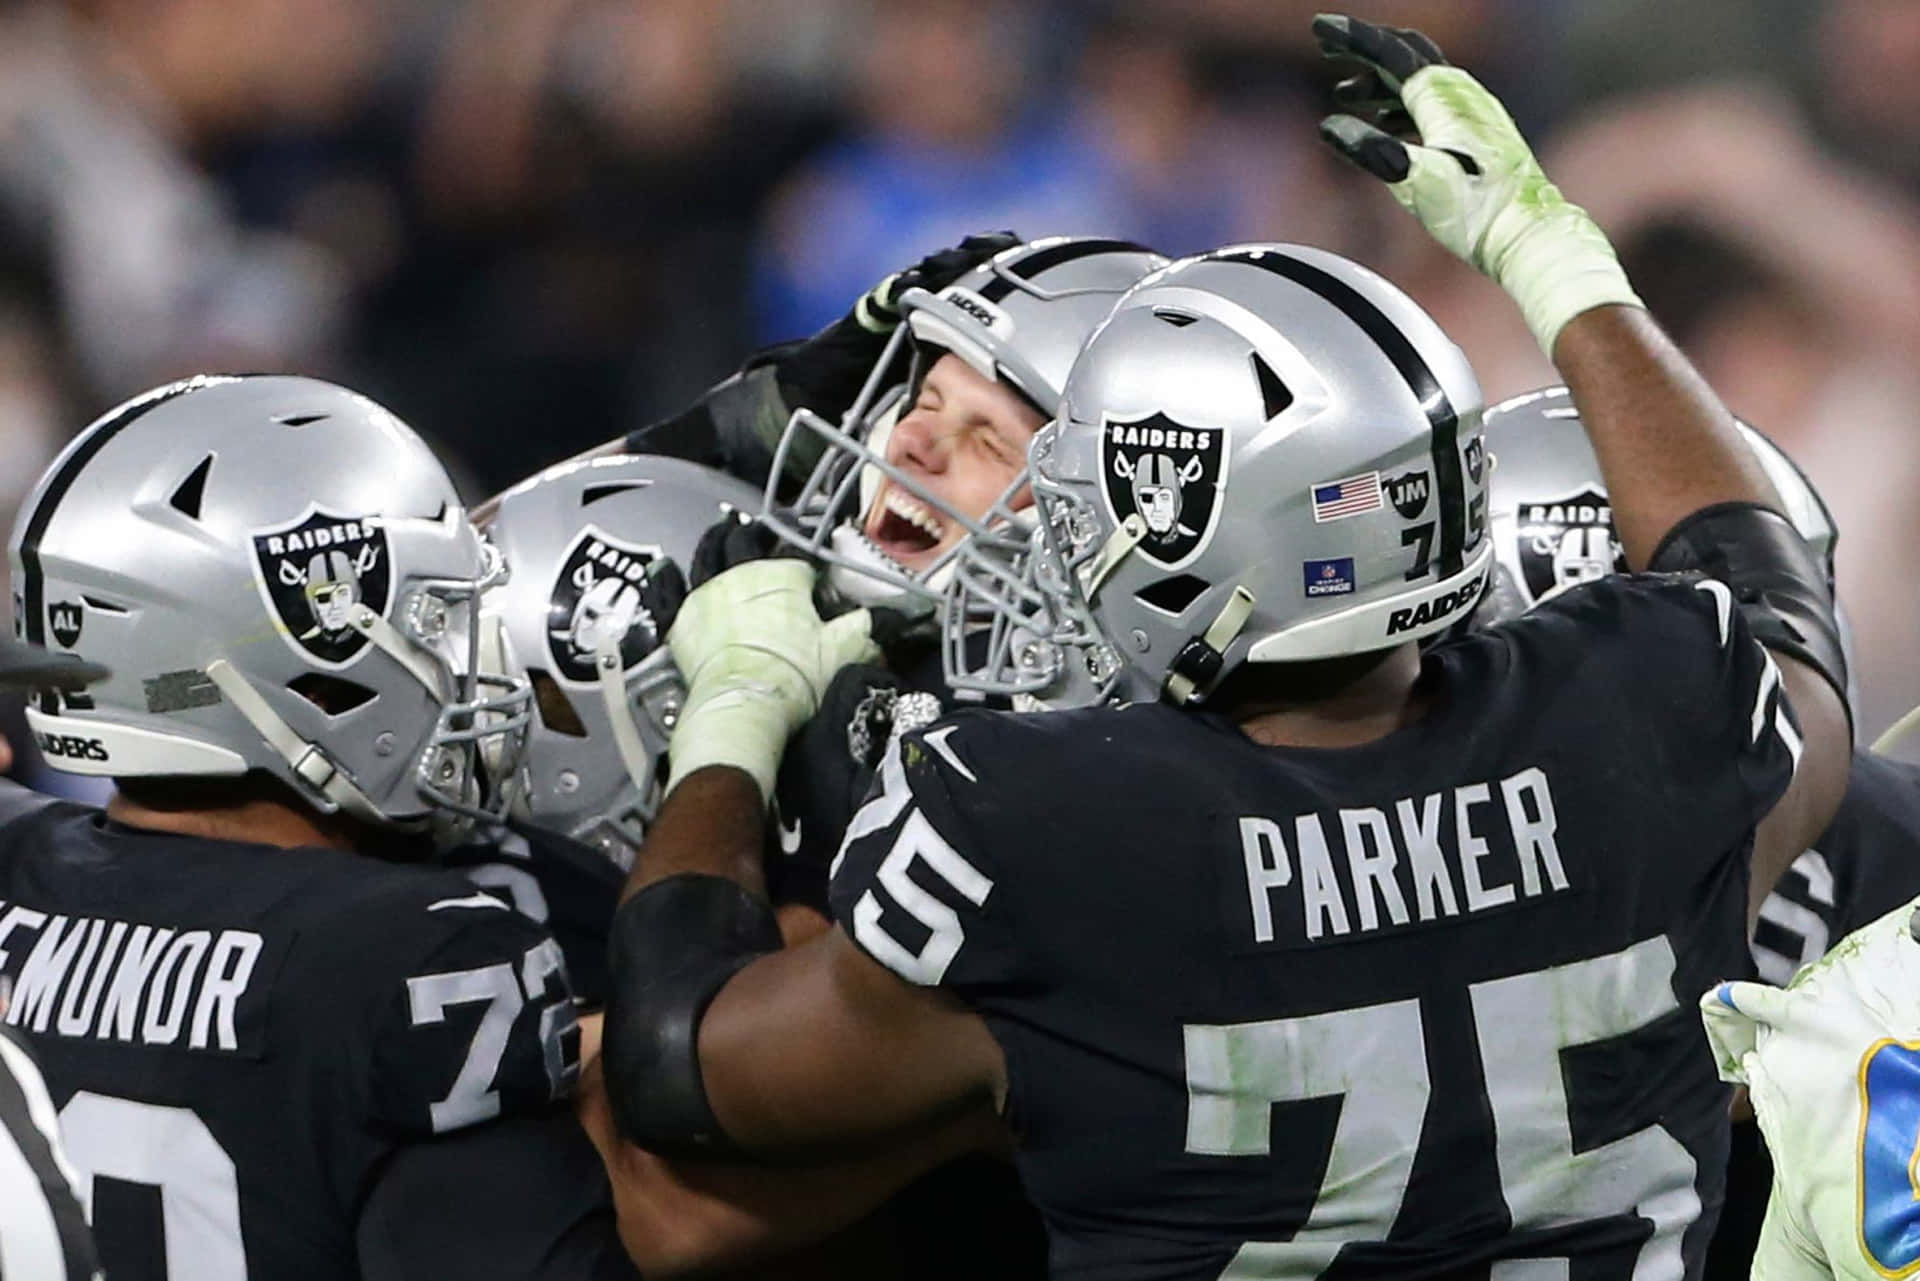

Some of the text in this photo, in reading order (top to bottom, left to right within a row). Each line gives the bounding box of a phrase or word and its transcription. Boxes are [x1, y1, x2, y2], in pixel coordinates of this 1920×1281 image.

[1111, 426, 1210, 450] RAIDERS
[1394, 479, 1427, 506] JM
[1528, 505, 1612, 524] RAIDE
[54, 611, 79, 631] AL
[1240, 766, 1570, 943] PARKER
[1183, 933, 1702, 1281] 75
